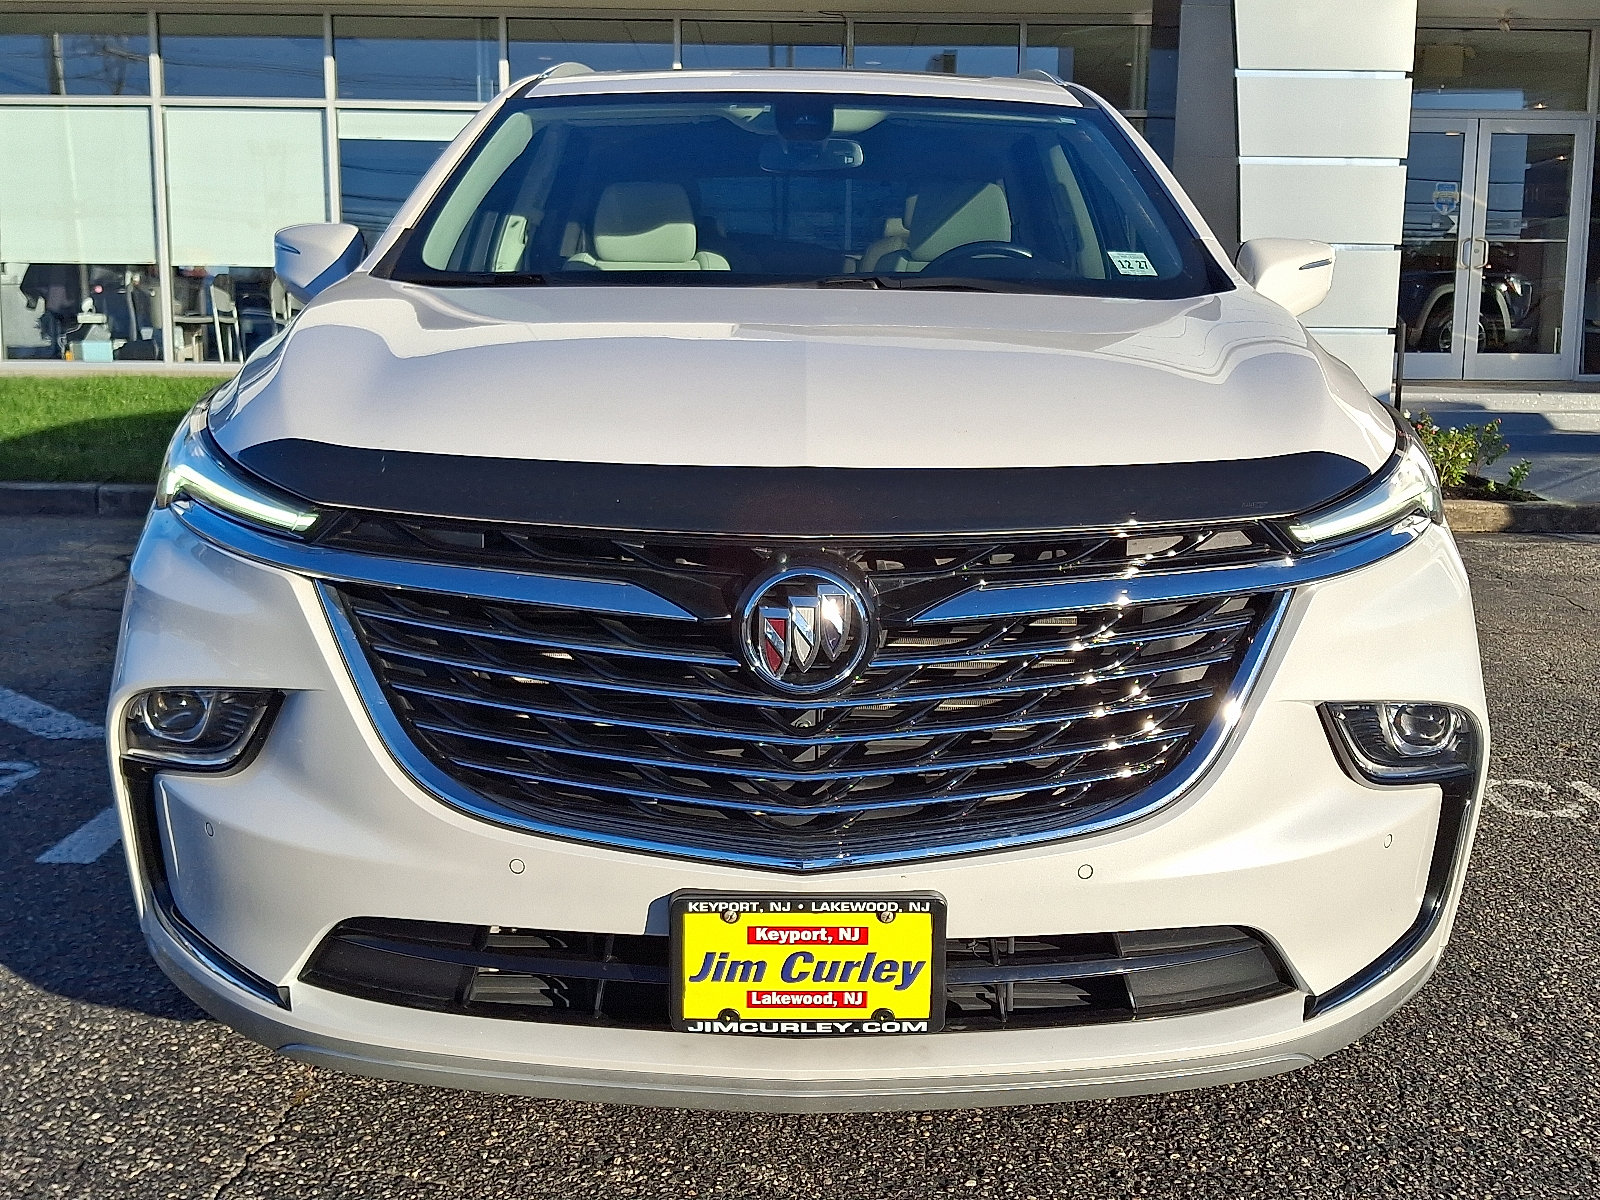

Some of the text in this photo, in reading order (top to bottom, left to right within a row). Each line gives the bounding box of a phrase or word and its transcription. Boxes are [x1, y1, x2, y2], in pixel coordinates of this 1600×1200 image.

[1118, 260, 1148, 270] 12 27
[688, 902, 764, 913] KEYPORT,
[770, 902, 791, 912] NJ
[909, 902, 930, 912] NJ
[755, 928, 860, 943] Keyport, NJ
[689, 951, 926, 990] Jim Curley
[751, 992, 863, 1007] Lakewood, NJ
[687, 1021, 928, 1033] JIMCURLEY.COM
